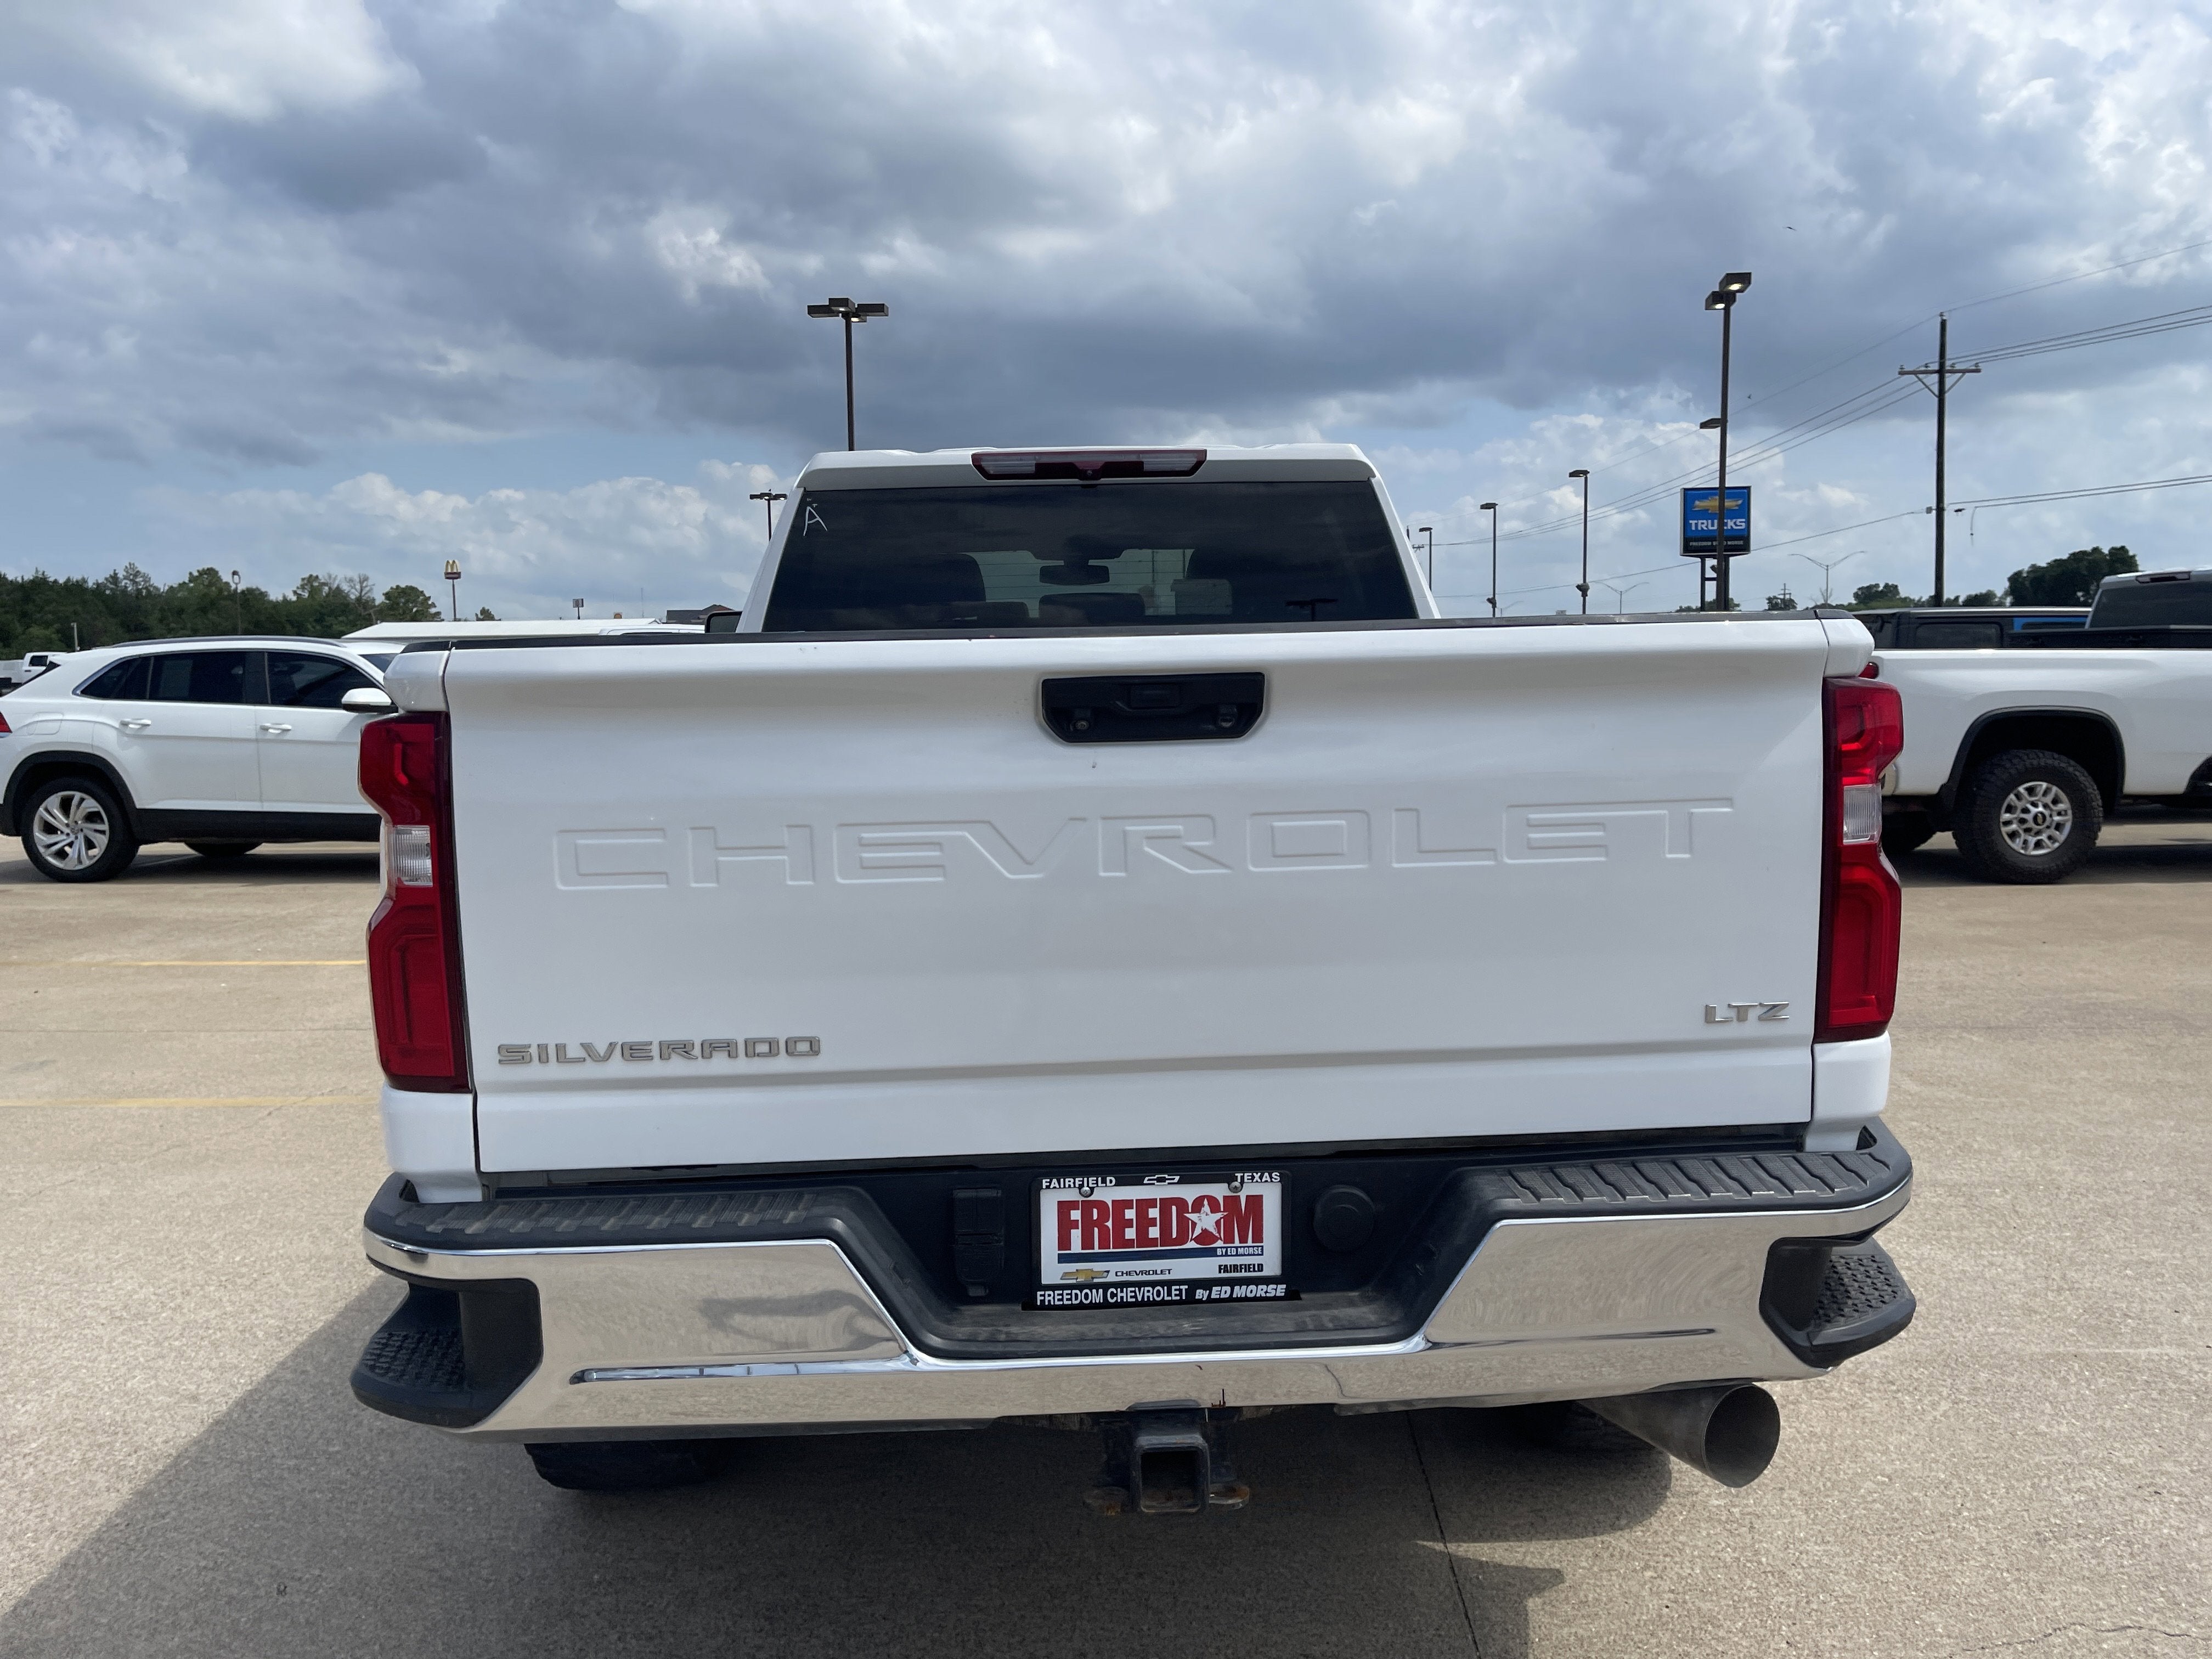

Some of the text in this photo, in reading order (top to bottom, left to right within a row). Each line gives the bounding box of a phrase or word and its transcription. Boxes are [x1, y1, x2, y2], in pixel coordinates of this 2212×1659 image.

[803, 506, 828, 537] A
[554, 797, 1734, 890] CHEVROLET
[1705, 1001, 1790, 1024] LTZ
[497, 1036, 821, 1064] SILVERADO
[1042, 1177, 1116, 1189] FAIRFIELD
[1235, 1172, 1281, 1183] TEXAS
[1057, 1194, 1264, 1251] FREEDOM
[1238, 1246, 1262, 1255] MORSE
[1115, 1268, 1173, 1277] CHEVROLET
[1218, 1263, 1264, 1274] FAIRFIELD
[1036, 1284, 1286, 1306] FREEDOM CHEVROLET By ED MORSE
